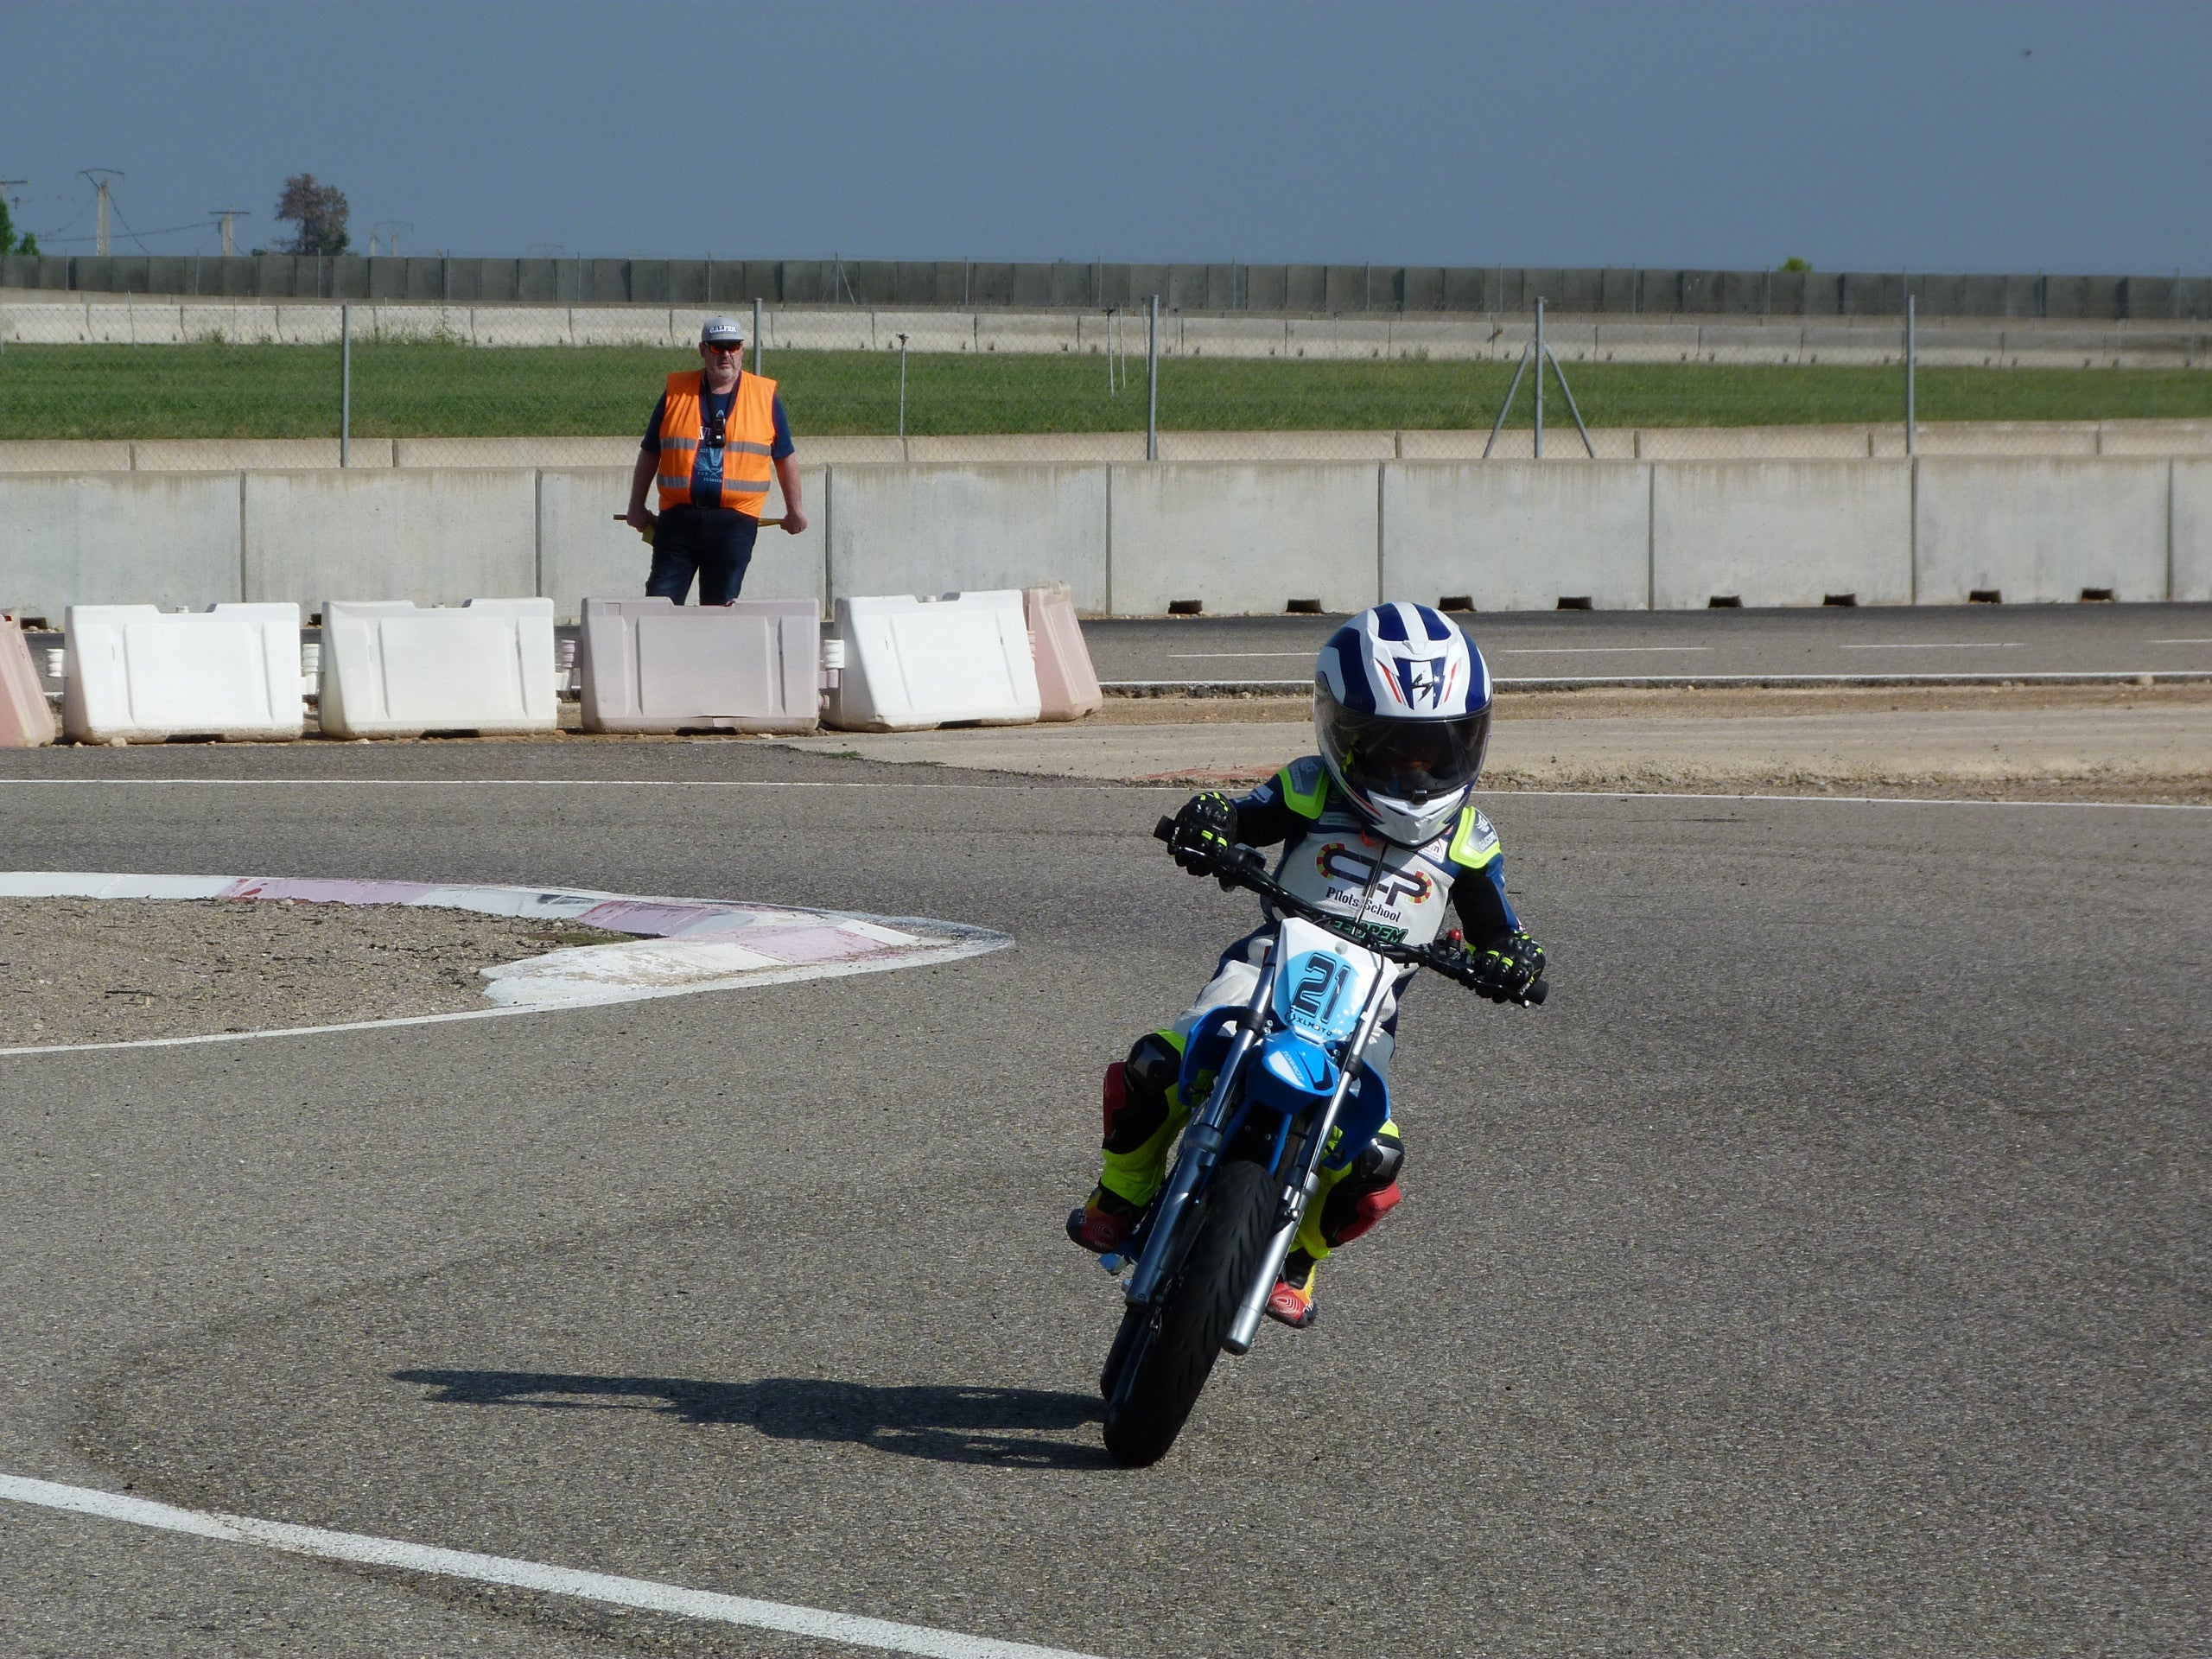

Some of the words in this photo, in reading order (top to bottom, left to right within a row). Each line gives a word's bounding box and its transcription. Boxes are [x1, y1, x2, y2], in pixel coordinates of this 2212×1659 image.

[709, 325, 737, 334] GALFER
[1325, 886, 1360, 907] Pilots
[1363, 897, 1402, 923] School
[1291, 952, 1351, 1024] 21
[1296, 1017, 1333, 1037] XLMOTO
